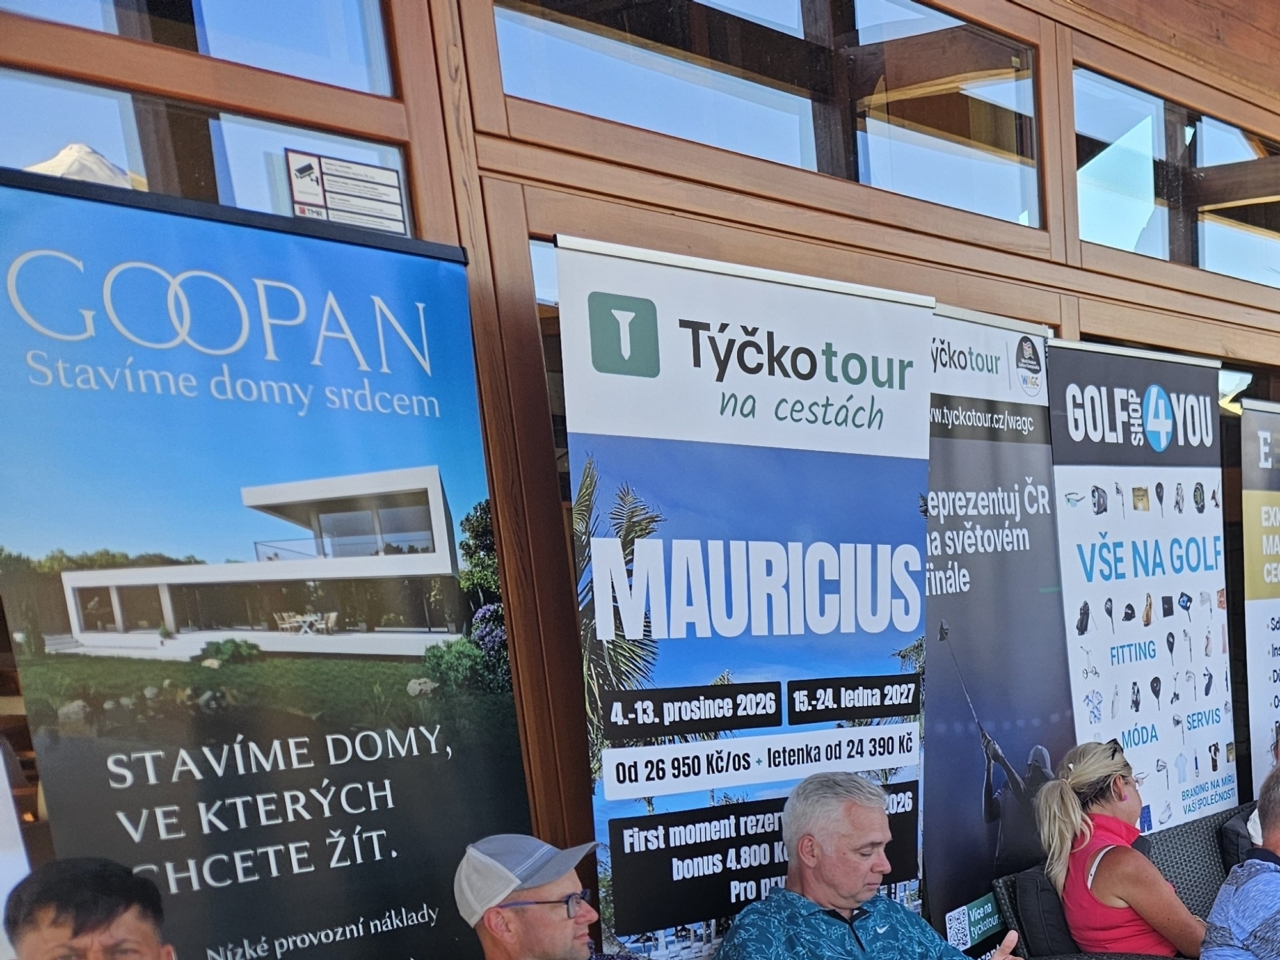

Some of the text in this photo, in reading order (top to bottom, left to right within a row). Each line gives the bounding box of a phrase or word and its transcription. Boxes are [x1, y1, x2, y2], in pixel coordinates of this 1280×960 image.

[306, 207, 323, 217] TMR
[7, 250, 433, 378] GOOPAN
[678, 319, 914, 391] Týčkotour
[931, 337, 1000, 374] ýčkotour
[26, 350, 441, 418] Stavíme domy srdcem
[719, 391, 884, 430] na cestách
[930, 406, 1034, 435] w.tyckotour.cz/wagc
[1065, 383, 1128, 444] GOLF
[1128, 389, 1144, 447] SHOP
[1170, 393, 1213, 447] YOU
[927, 477, 1051, 524] eprezentuj ČR
[945, 520, 1030, 555] světovém
[1076, 532, 1221, 583] VŠE NA GOLF
[591, 536, 922, 640] MAURICIUS
[1110, 641, 1156, 666] FITTING
[611, 692, 776, 726] 4.-13. prosince 2026
[793, 684, 916, 712] 15.-24. ledna 2027
[1121, 722, 1159, 749] MÓDA
[1186, 708, 1221, 731] SERVIS
[107, 725, 453, 789] STAVÍME DOMY,
[615, 761, 639, 784] Od
[645, 758, 666, 781] 26
[671, 755, 700, 777] 950
[706, 749, 751, 775] Kč/os
[767, 743, 821, 768] letenka
[825, 741, 842, 761] od
[846, 738, 864, 758] 24
[869, 735, 894, 756] 390
[898, 732, 913, 755] Kč
[1181, 782, 1209, 801] BRANDING
[1210, 779, 1220, 790] NA
[116, 778, 395, 843] VE KTERÝCH
[623, 826, 665, 853] First
[669, 815, 736, 848] moment
[740, 811, 784, 836] rezer
[132, 825, 398, 894] HCETE ŽÍT.
[672, 853, 723, 881] bonus
[726, 843, 769, 870] 4.800
[730, 881, 757, 903] Pro
[984, 903, 992, 914] na
[274, 917, 364, 959] provozní
[369, 903, 439, 935] náklady
